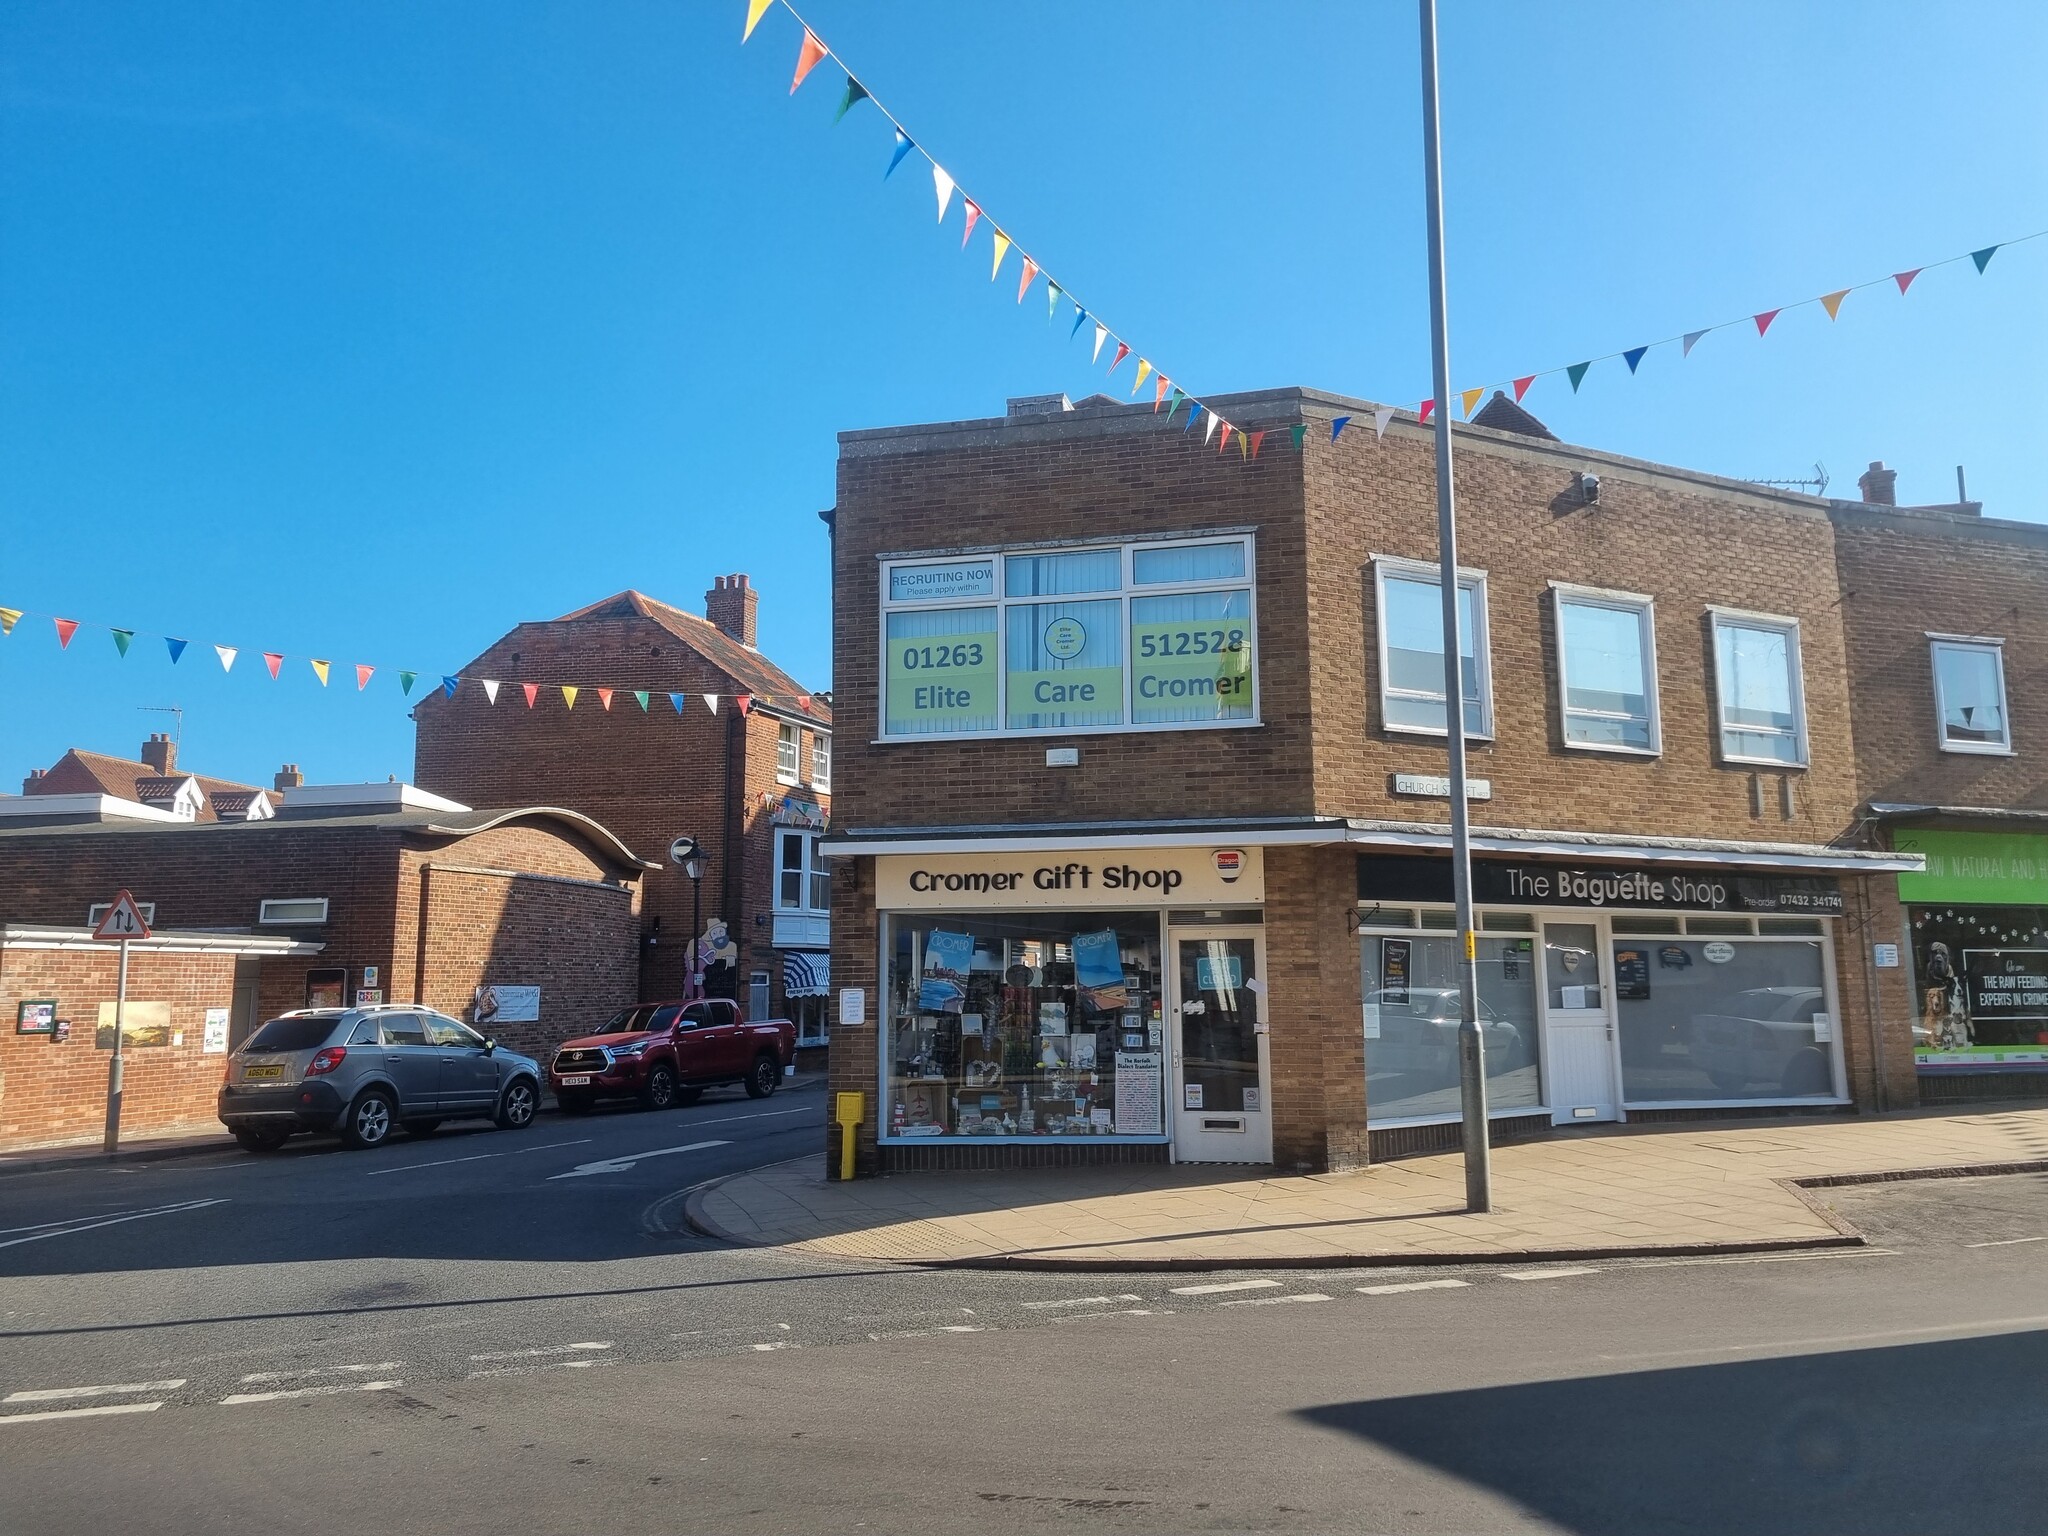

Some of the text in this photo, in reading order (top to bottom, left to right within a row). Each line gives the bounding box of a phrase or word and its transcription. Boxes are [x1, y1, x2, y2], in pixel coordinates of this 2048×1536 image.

[892, 571, 963, 586] RECRUITING
[907, 583, 980, 596] Please apply within
[903, 629, 1244, 670] 01263 512528
[914, 674, 1245, 710] Elite Care Cromer
[1397, 781, 1439, 794] CHURCH
[1922, 856, 1944, 877] AW
[1952, 856, 2007, 879] NATURAL
[2011, 857, 2036, 880] AND
[909, 863, 1182, 895] Cromer Gift Shop
[1506, 869, 1726, 909] The Baguette Shop
[1744, 894, 1842, 908] Pre-order 07432 341741
[931, 935, 970, 951] CROMER
[1983, 976, 2048, 989] THE RAW FEEDING
[1979, 993, 2012, 1006] EXPERTS
[2012, 993, 2022, 1006] IN
